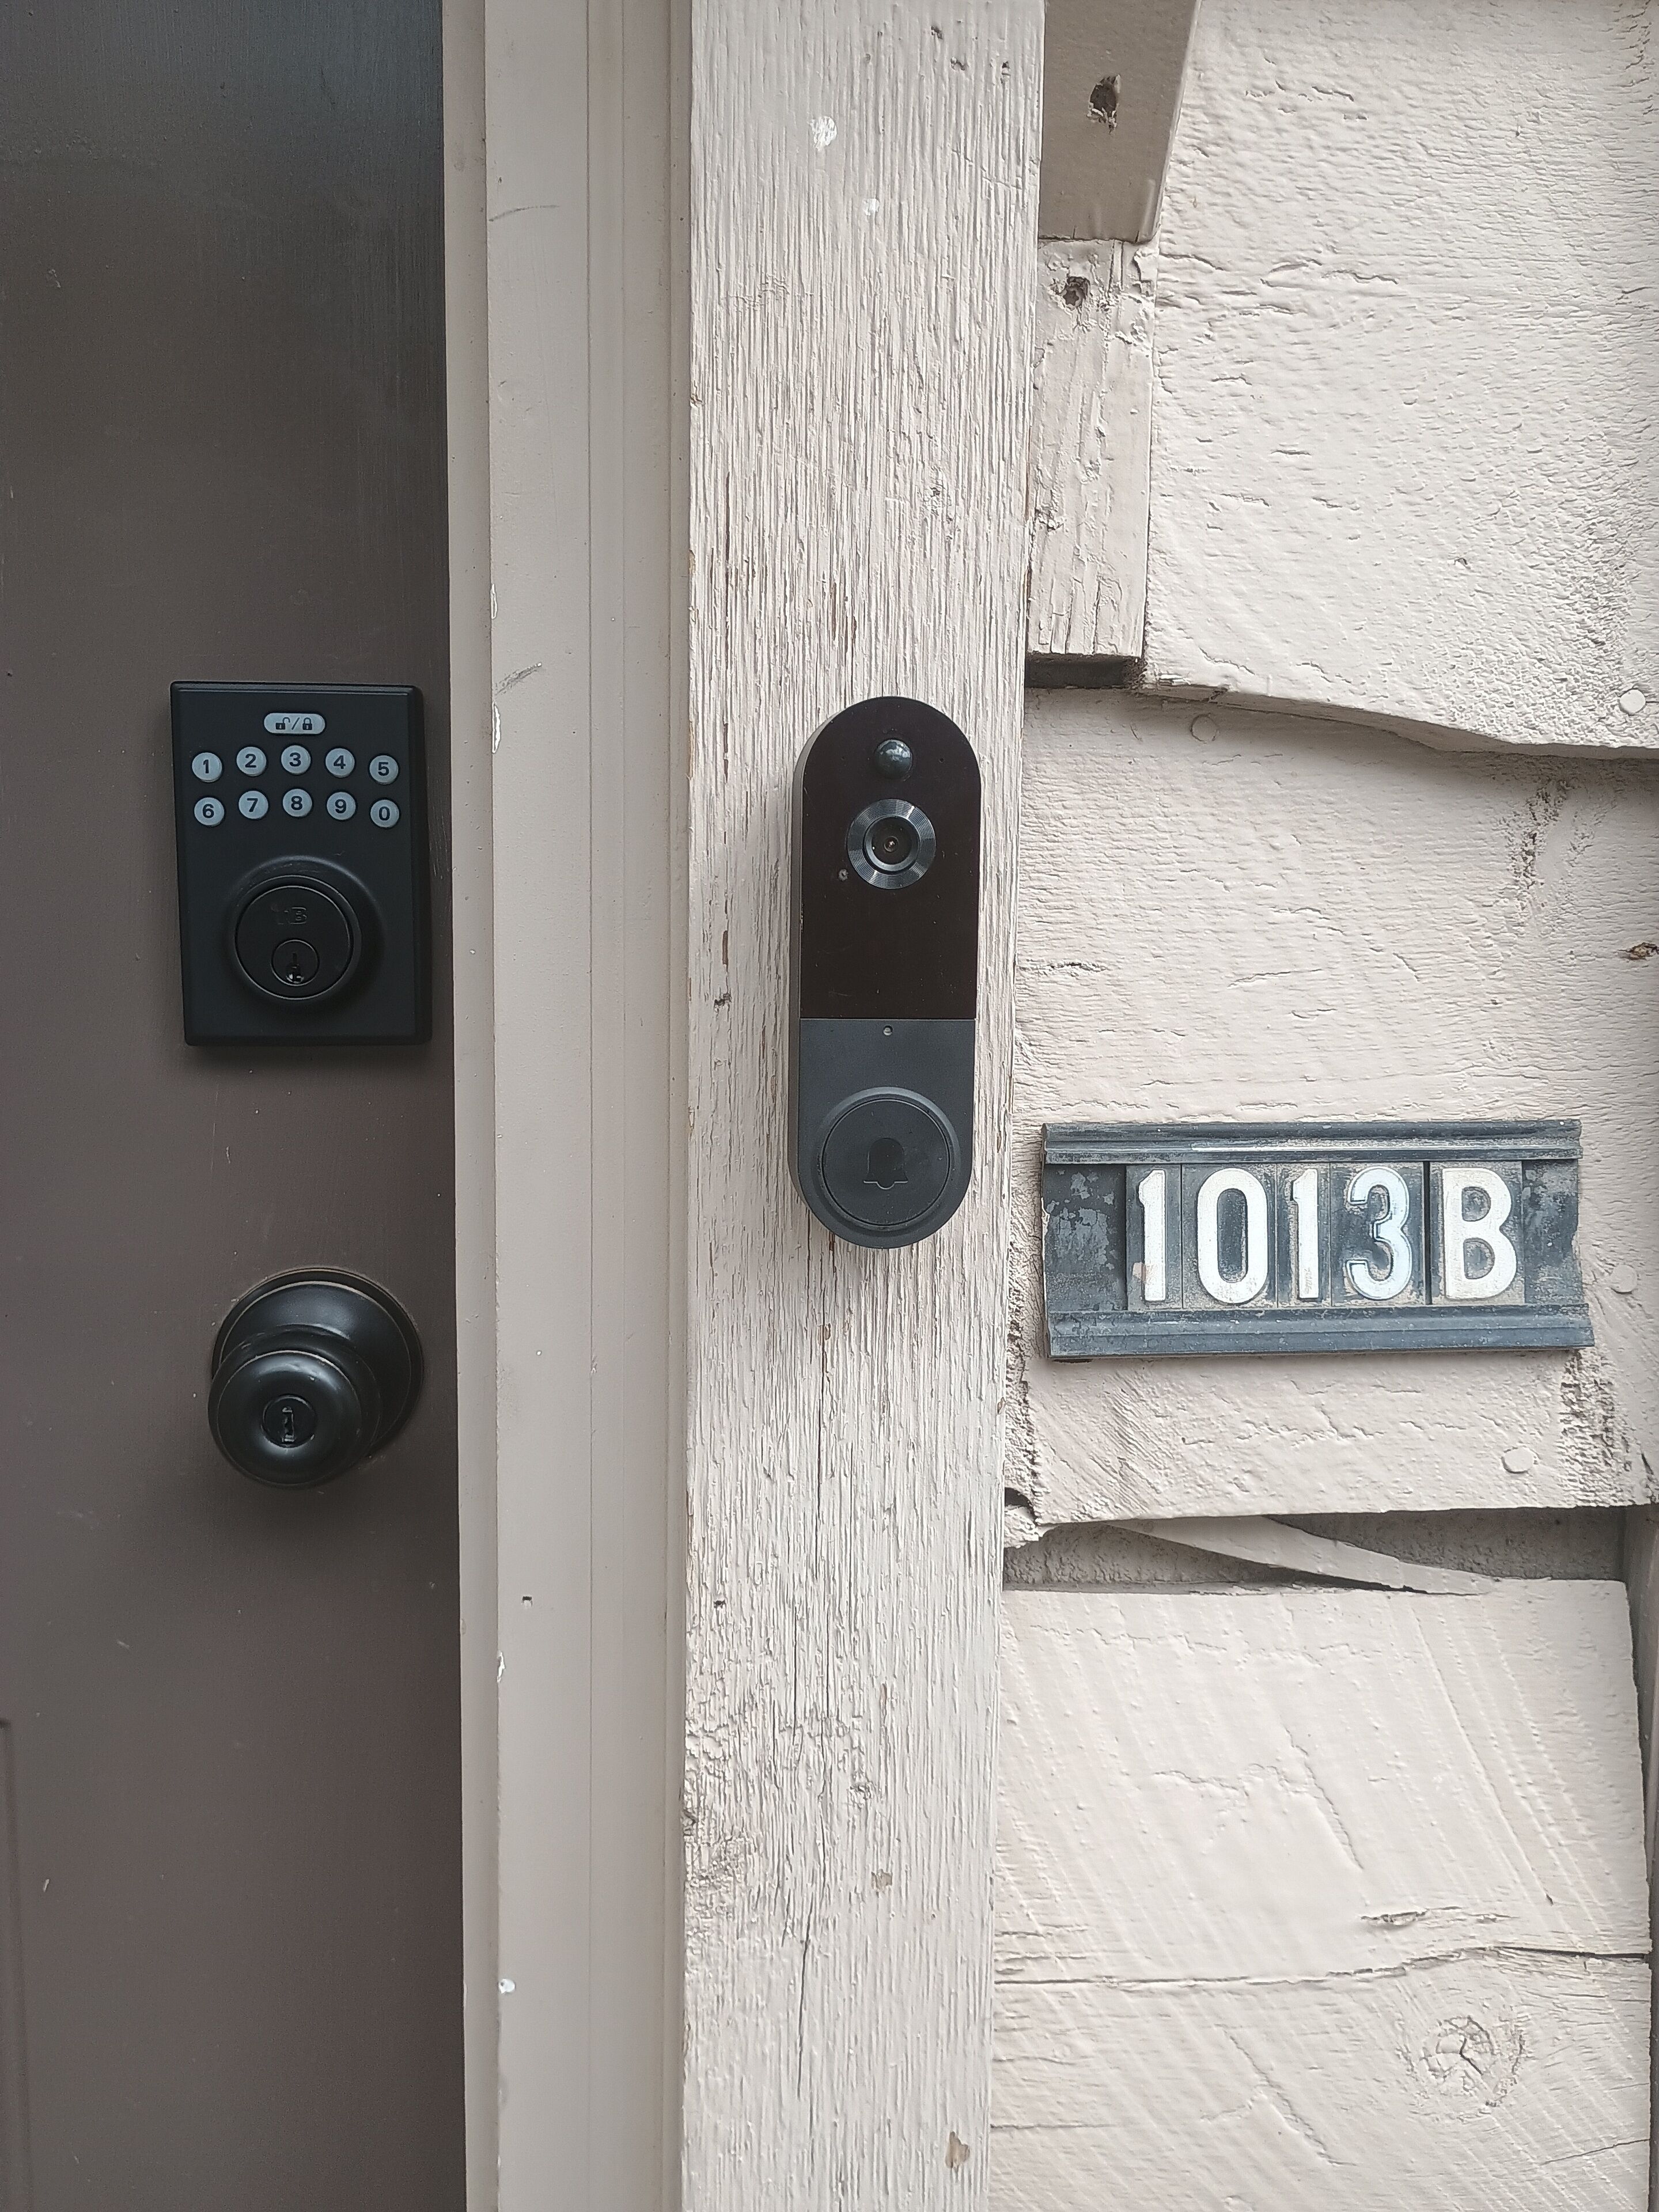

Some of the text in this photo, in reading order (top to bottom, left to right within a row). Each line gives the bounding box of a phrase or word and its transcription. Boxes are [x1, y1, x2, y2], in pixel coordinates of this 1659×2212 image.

[202, 752, 389, 777] 1 2 3 4 5
[202, 796, 391, 821] 6 7 8 9 0
[1138, 1166, 1517, 1305] 1013B
